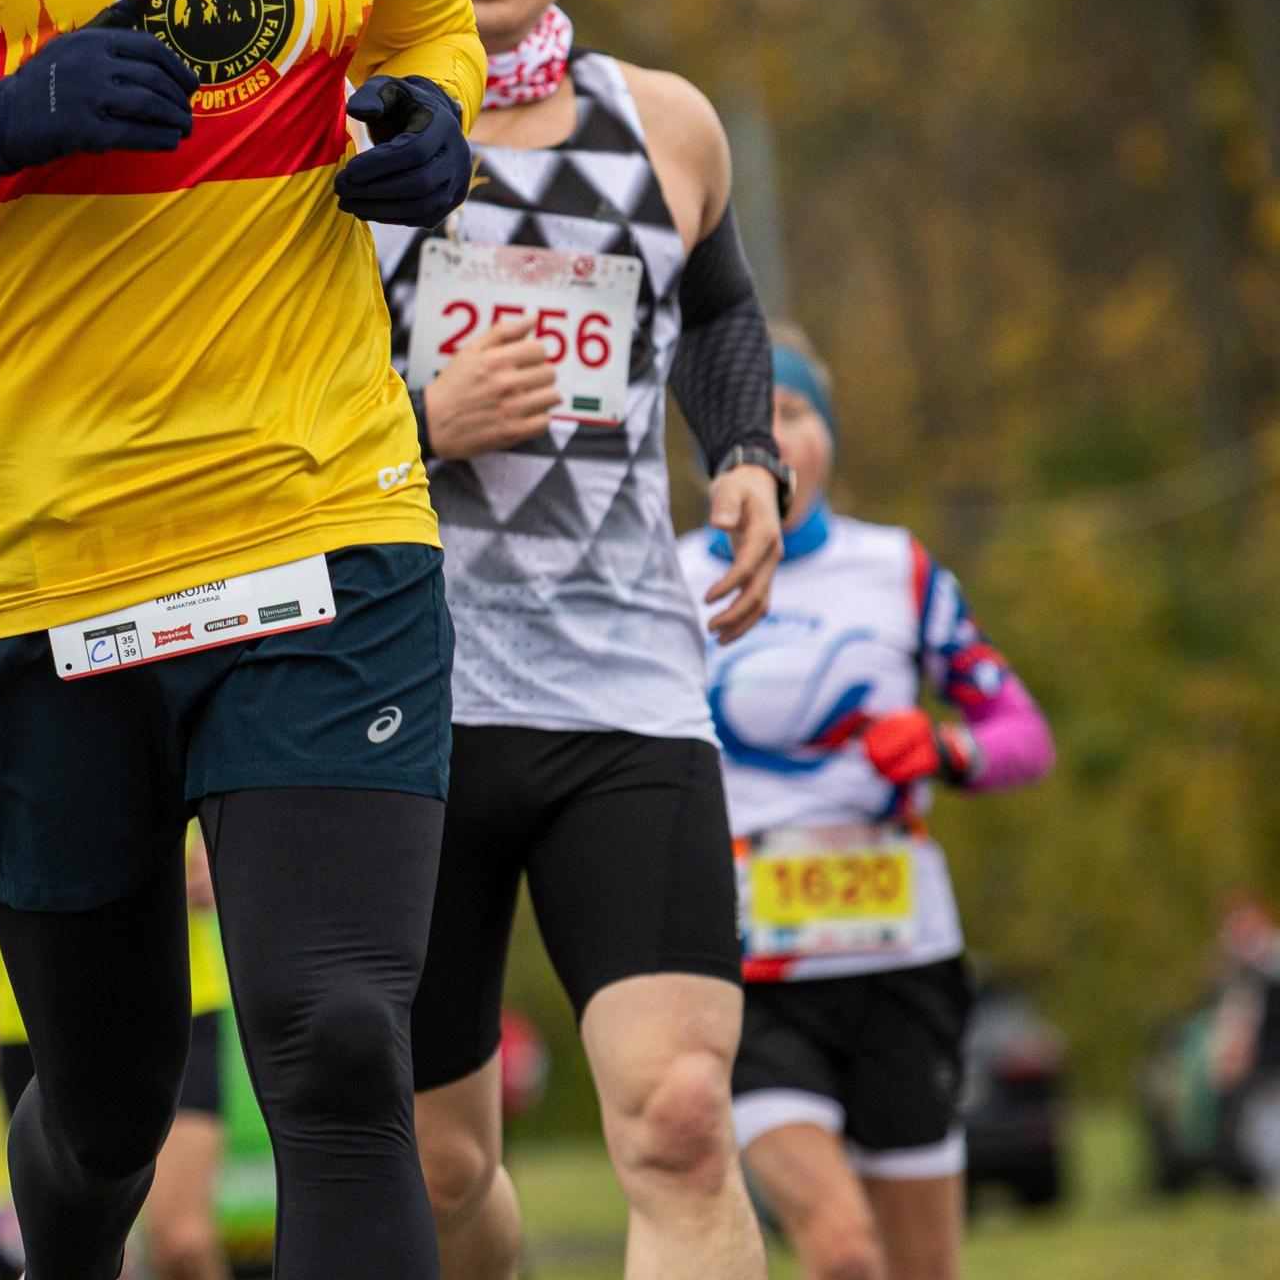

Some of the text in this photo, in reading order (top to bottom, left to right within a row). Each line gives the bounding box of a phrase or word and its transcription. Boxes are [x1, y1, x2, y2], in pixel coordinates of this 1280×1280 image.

[189, 68, 271, 111] PORTERS
[166, 595, 221, 611] ФАНАТИК СКВАД
[260, 605, 299, 618] Примавера
[206, 617, 239, 631] WINLINE
[121, 635, 135, 645] 35
[123, 648, 137, 658] 39
[775, 854, 903, 907] 1620
